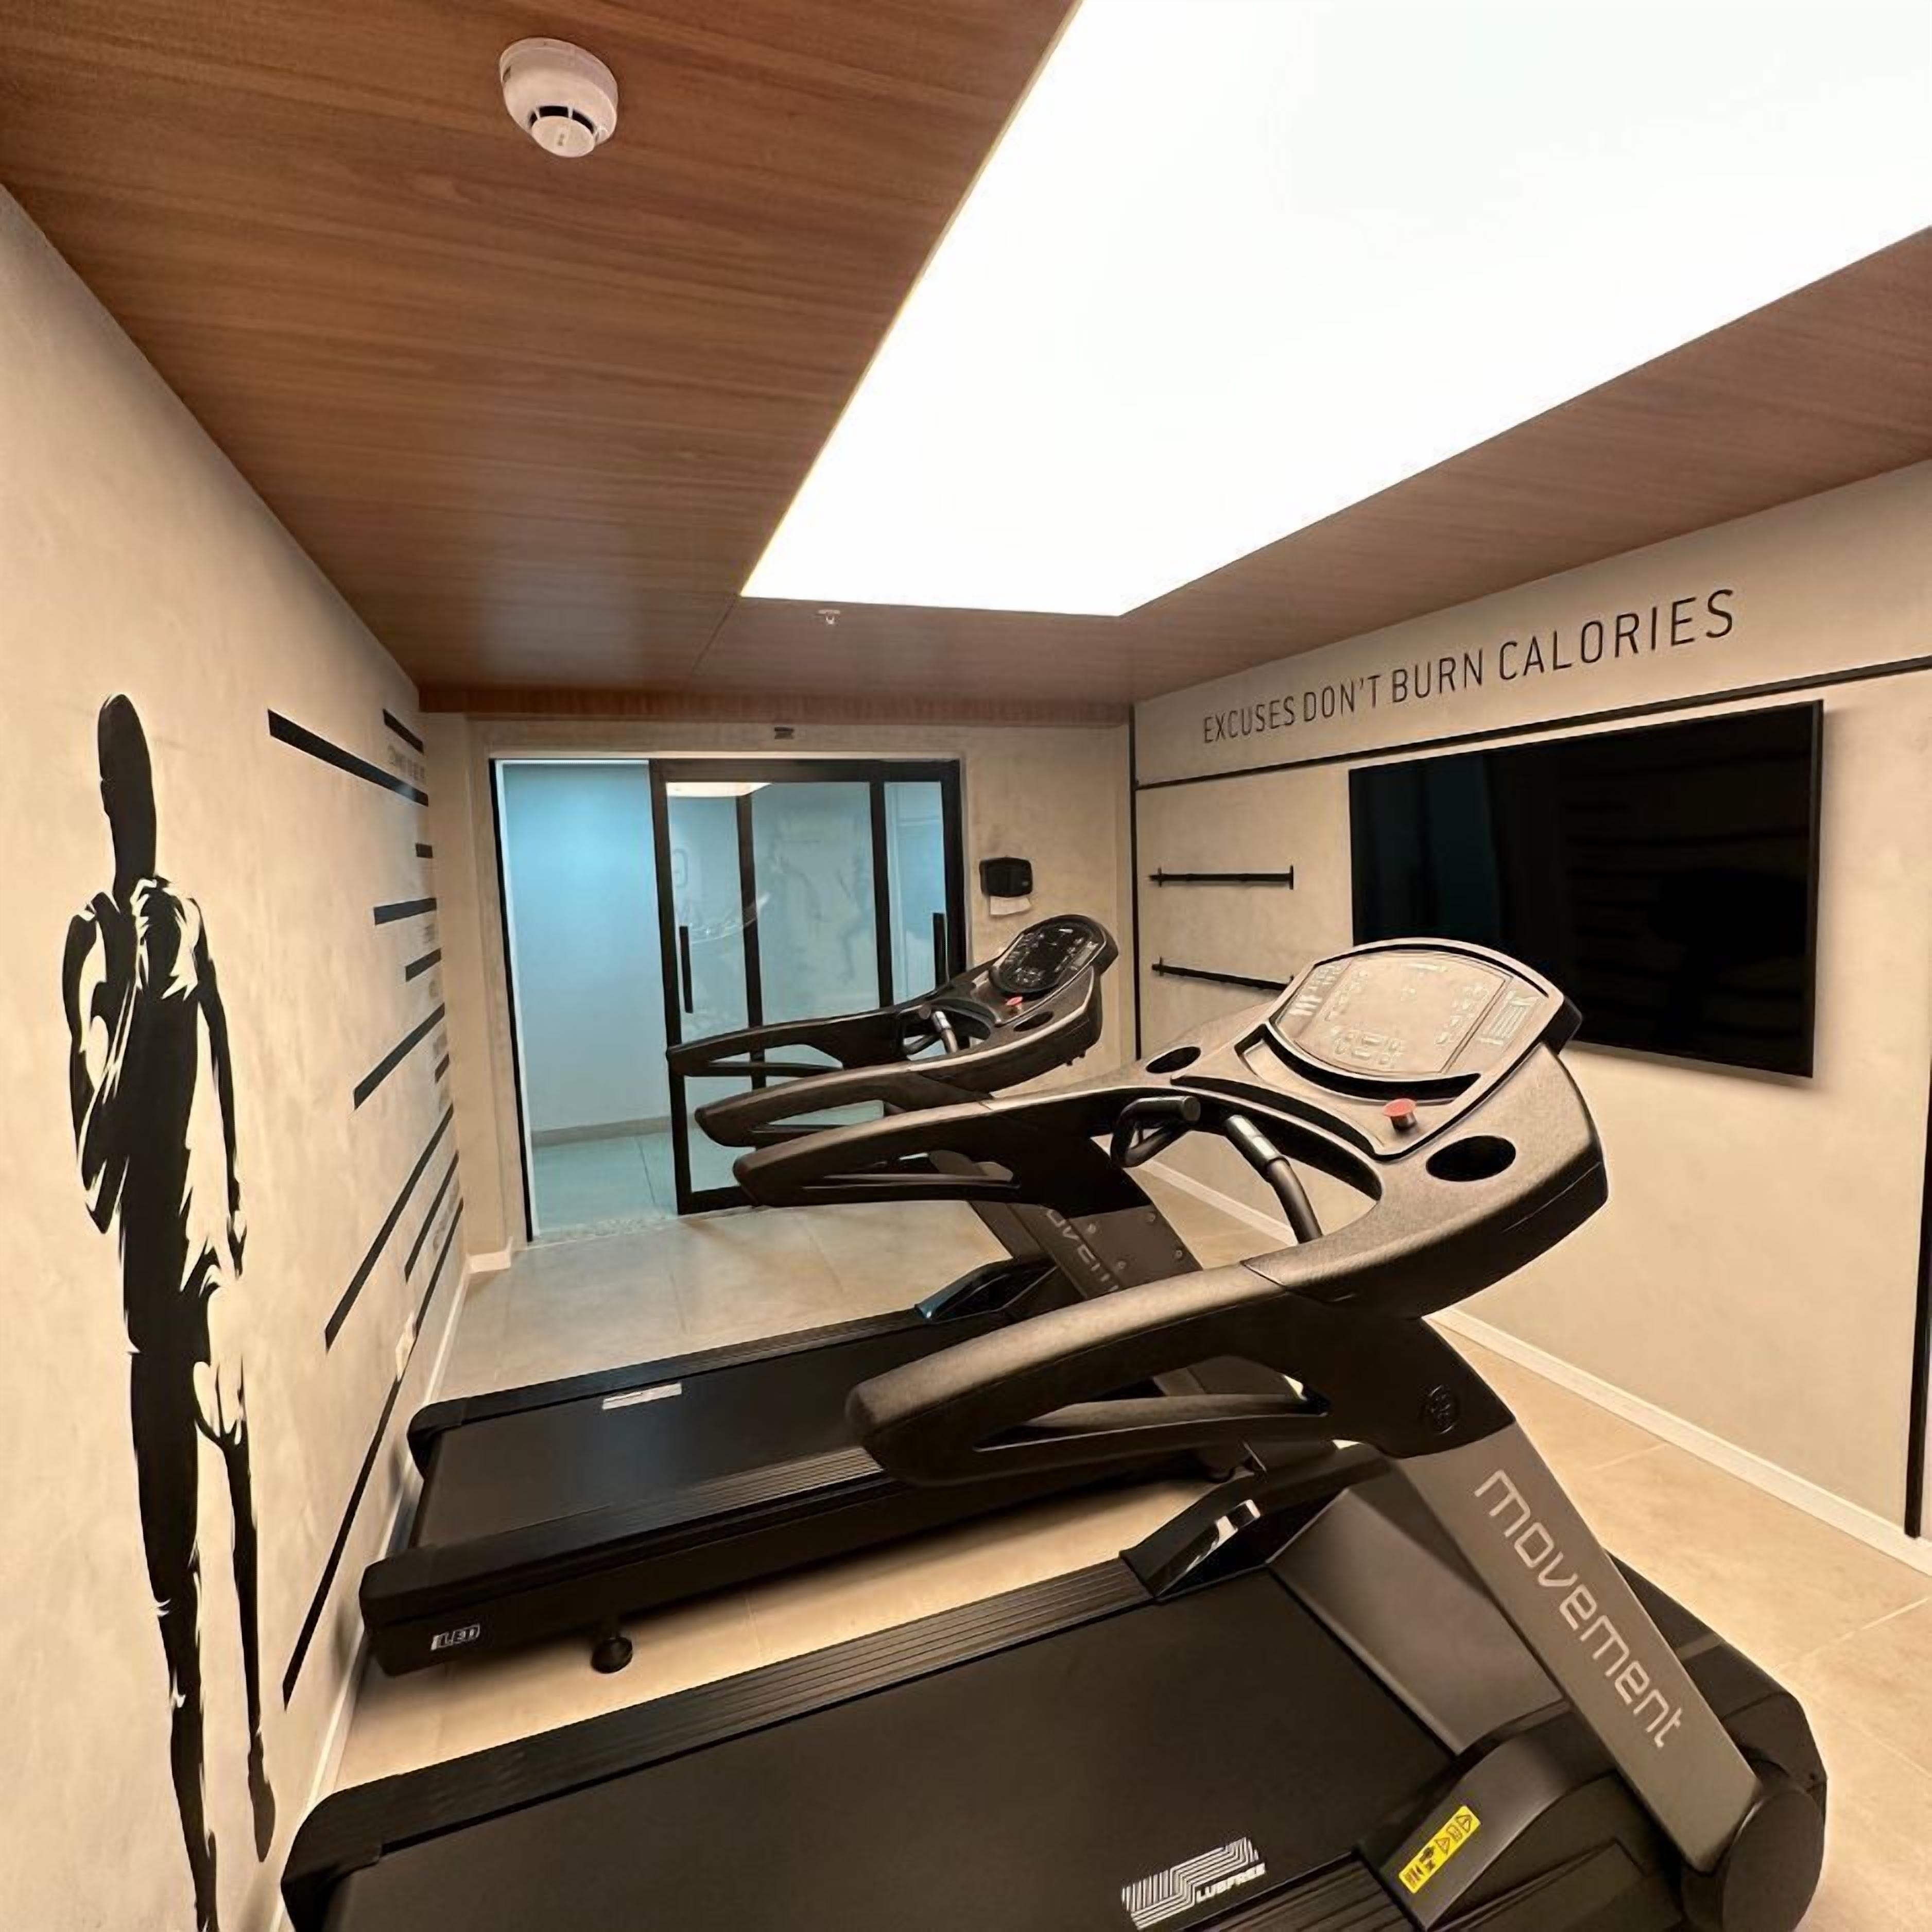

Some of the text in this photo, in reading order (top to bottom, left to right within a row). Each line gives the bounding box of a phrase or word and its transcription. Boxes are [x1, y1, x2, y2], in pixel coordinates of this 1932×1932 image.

[1203, 588, 1735, 744] EXCUSES DON'T BURN CALORIES
